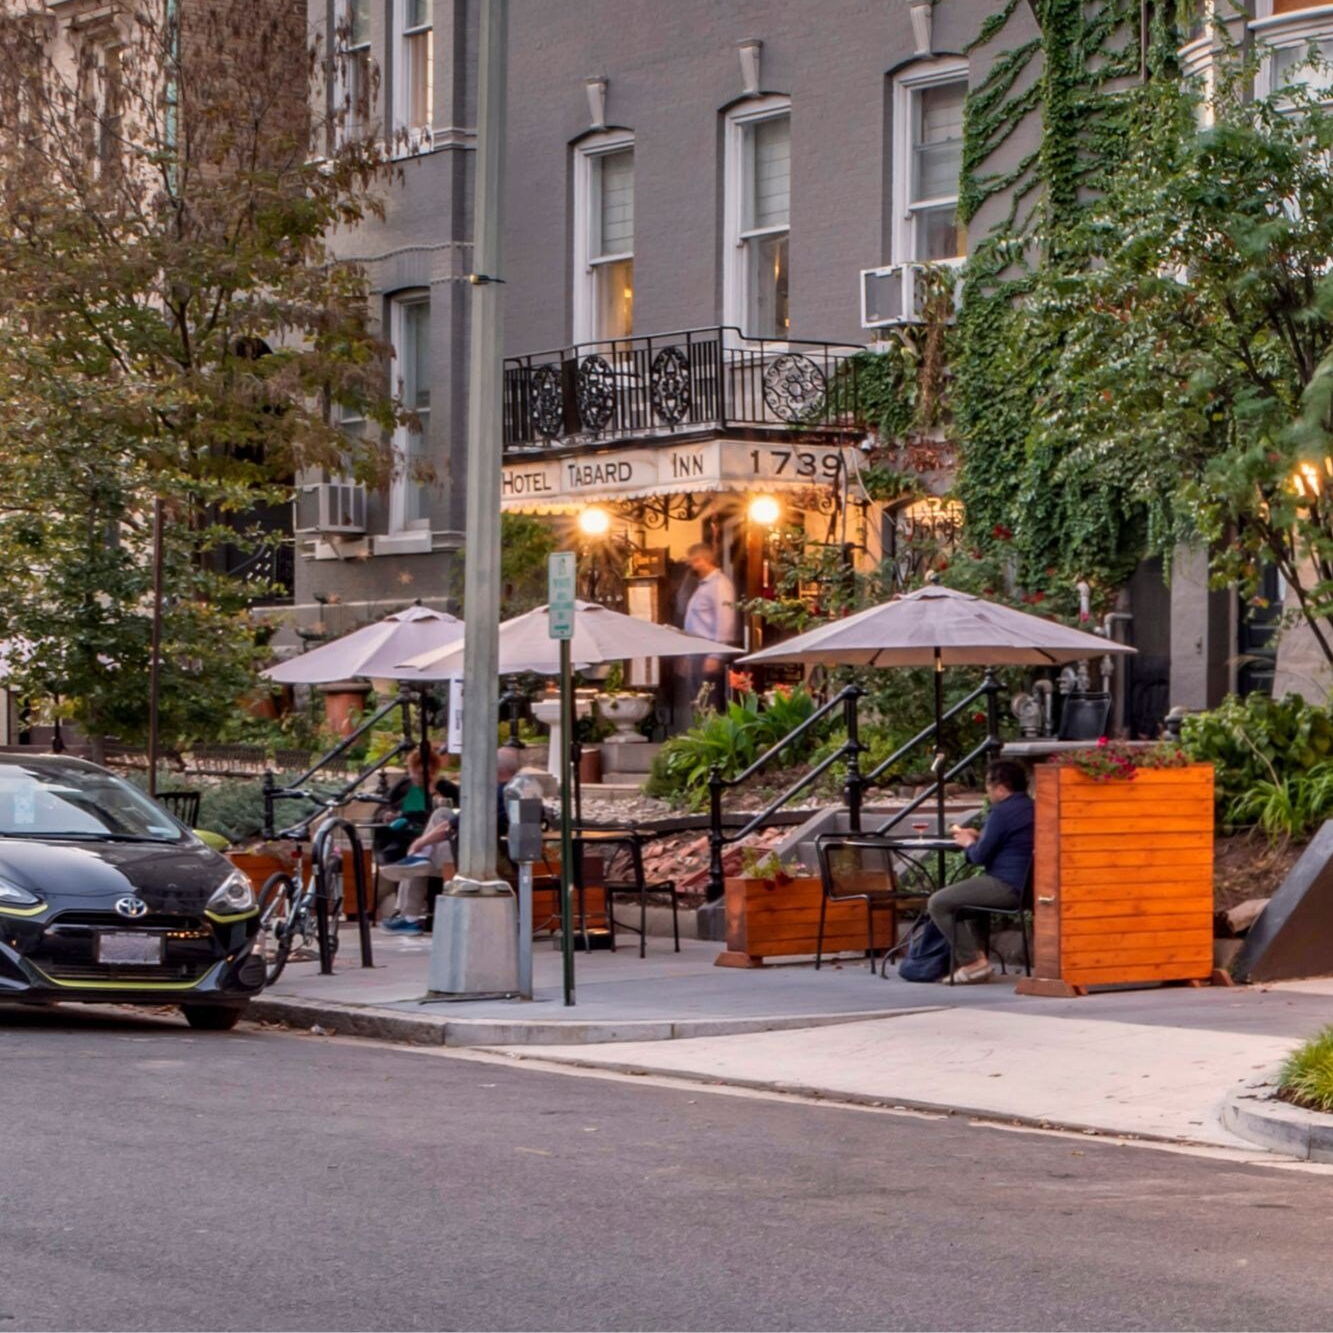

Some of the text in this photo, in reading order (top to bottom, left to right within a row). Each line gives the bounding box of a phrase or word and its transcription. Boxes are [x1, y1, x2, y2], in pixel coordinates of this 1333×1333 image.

[502, 450, 841, 494] HOTEL TABARD INN 1739
